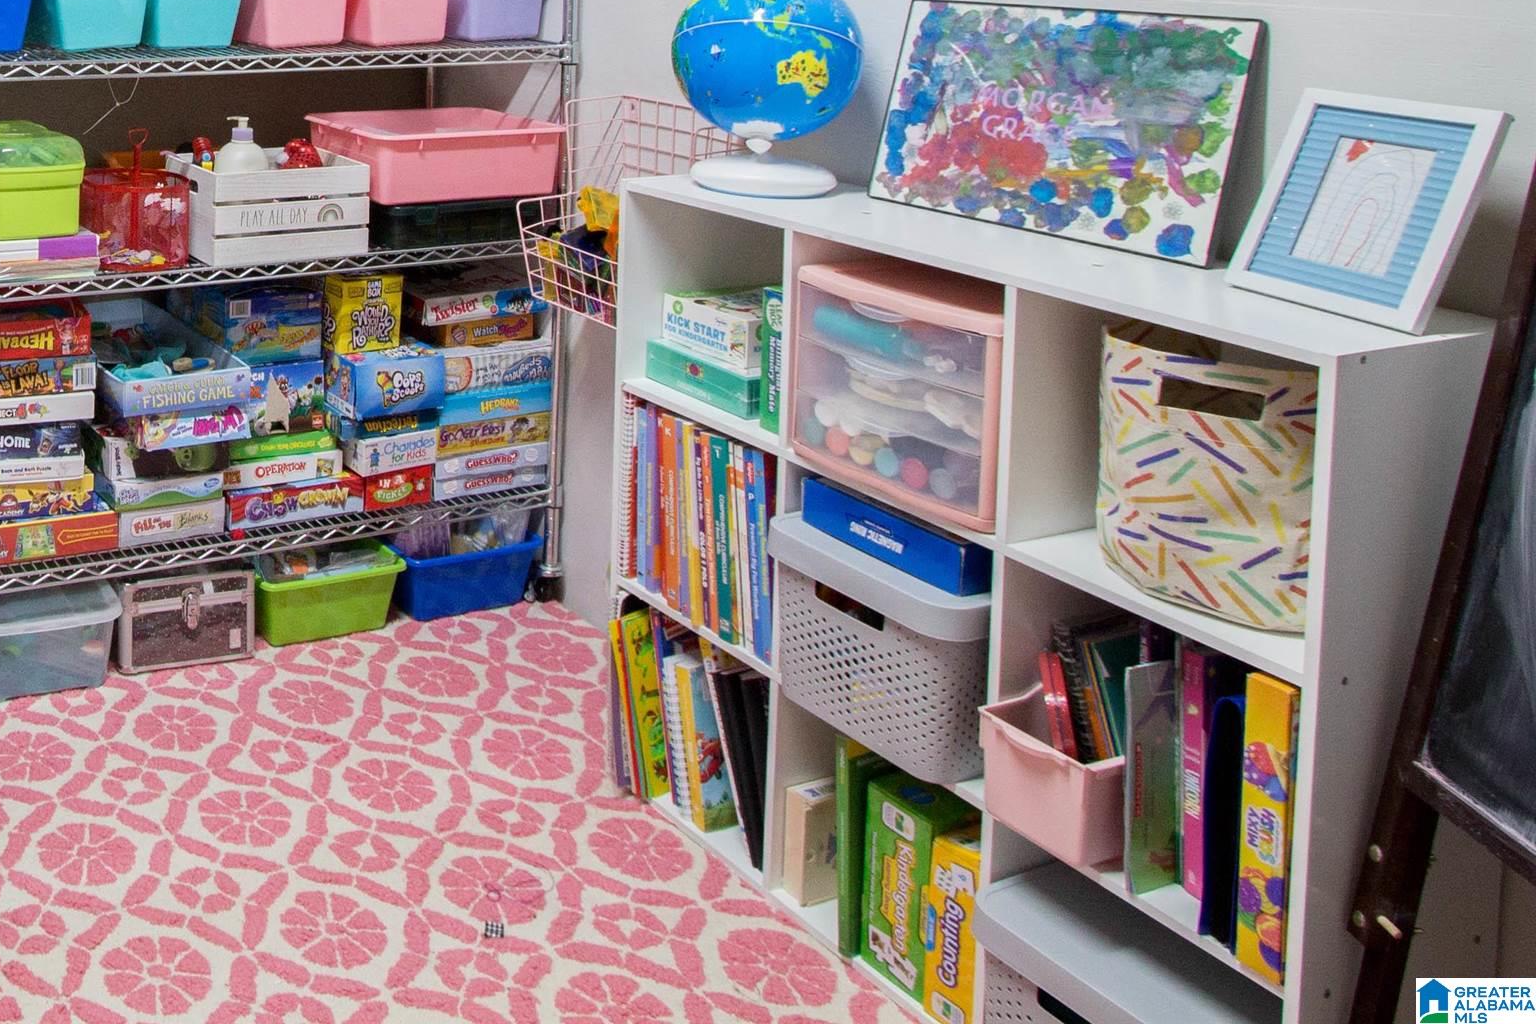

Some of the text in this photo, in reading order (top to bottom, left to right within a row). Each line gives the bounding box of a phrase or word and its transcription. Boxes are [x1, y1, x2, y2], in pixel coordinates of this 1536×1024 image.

[977, 85, 1116, 118] MORGAN
[240, 206, 309, 228] PLAY ALL DAY
[430, 296, 479, 322] Twister
[472, 324, 499, 337] Watch
[666, 312, 727, 342] KICK START
[11, 372, 49, 395] LAVA!
[767, 336, 777, 413] Memory Mate
[142, 386, 236, 409] FISHING GAME
[383, 434, 436, 457] Charades
[391, 450, 405, 463] for
[406, 447, 428, 462] Kids
[255, 462, 306, 479] OPERATION
[466, 450, 519, 470] GUESS WHO?
[464, 471, 514, 490] GUESS WHO?
[718, 494, 729, 585] COMPREHENSIVE CURRICULUM
[1182, 769, 1202, 820] UNICORN
[1246, 807, 1261, 848] MIXY
[892, 843, 914, 952] Kindergarten
[937, 897, 965, 989] Counting
